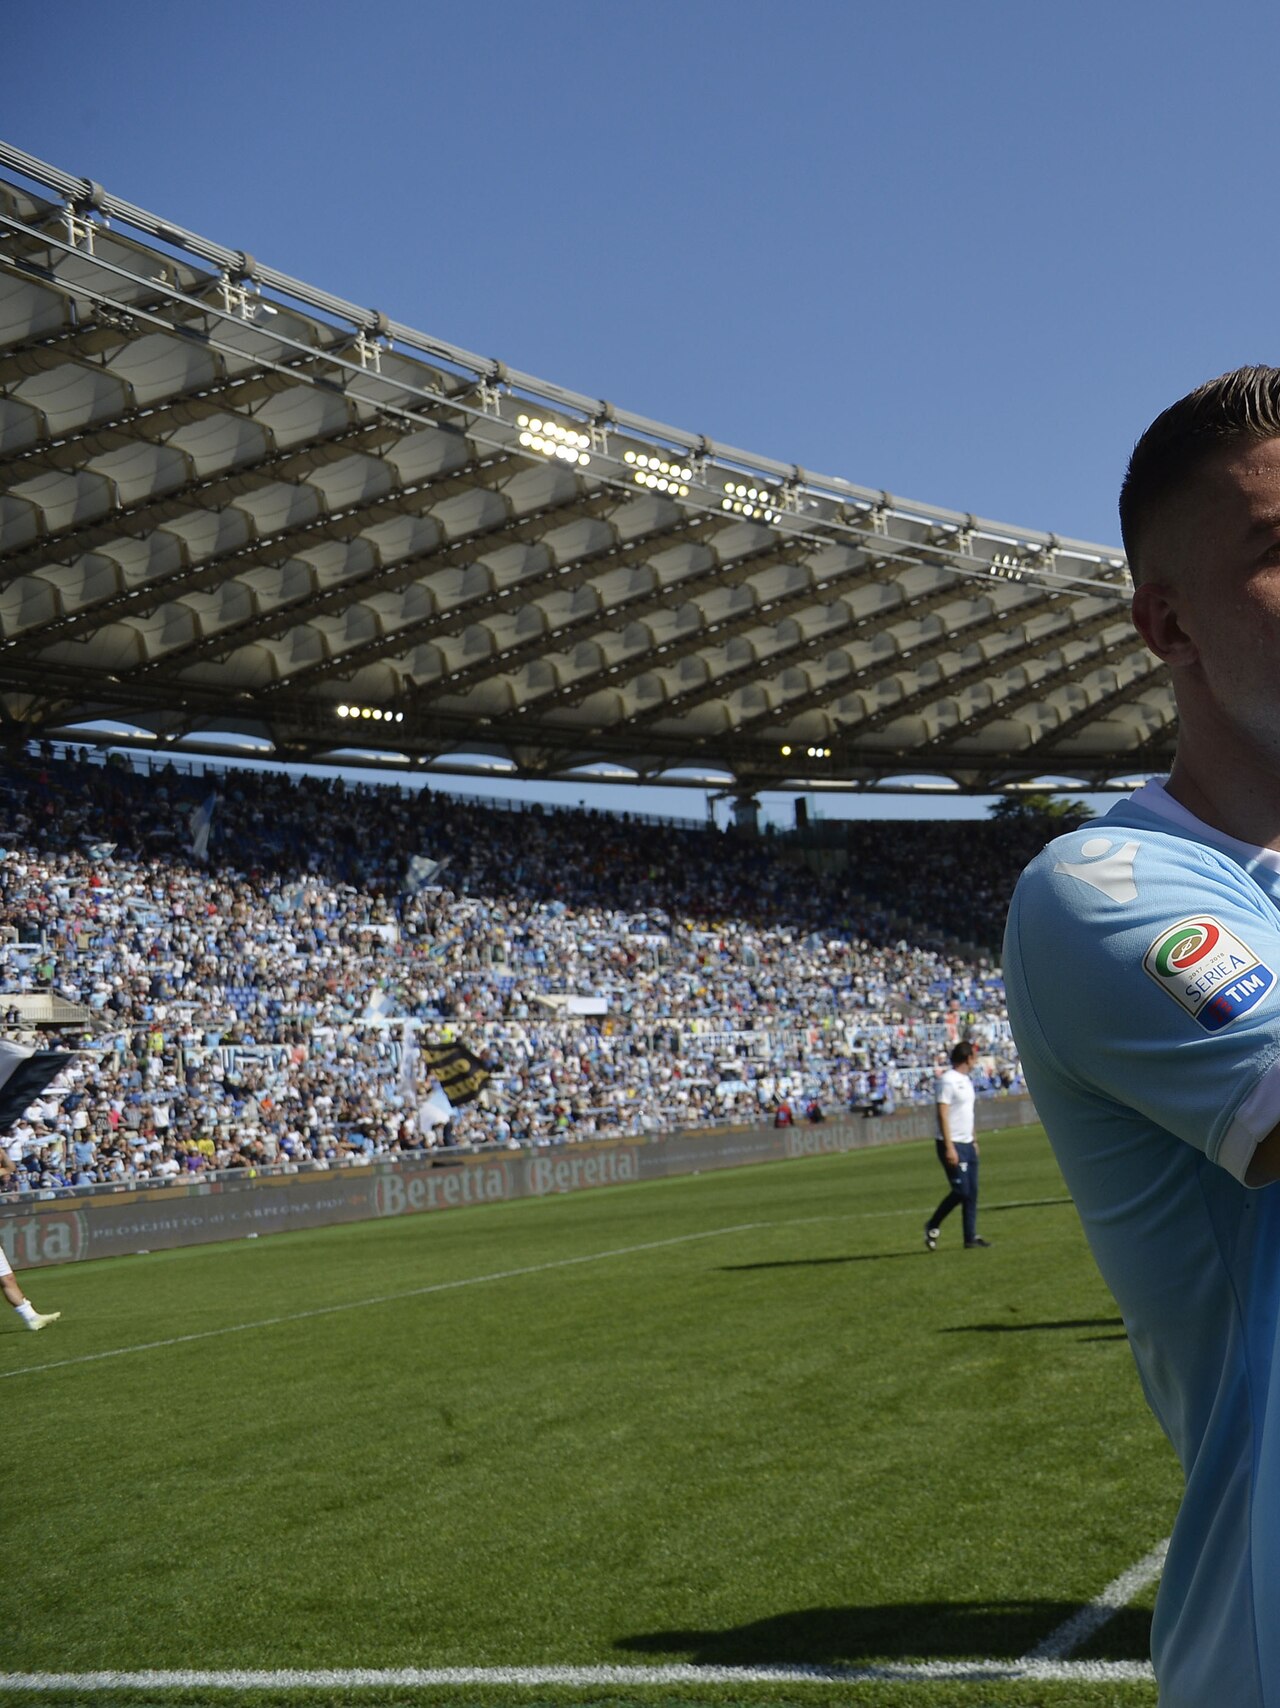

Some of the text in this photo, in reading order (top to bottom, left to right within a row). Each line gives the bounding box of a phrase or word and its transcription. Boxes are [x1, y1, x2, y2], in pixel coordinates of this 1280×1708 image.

[1185, 954, 1246, 1003] SERIE A
[1188, 952, 1225, 980] 2017 2018
[1224, 973, 1265, 1003] TIM
[791, 1123, 855, 1157] Beretta
[381, 1165, 504, 1216] Beretta
[535, 1152, 635, 1196] Beretta
